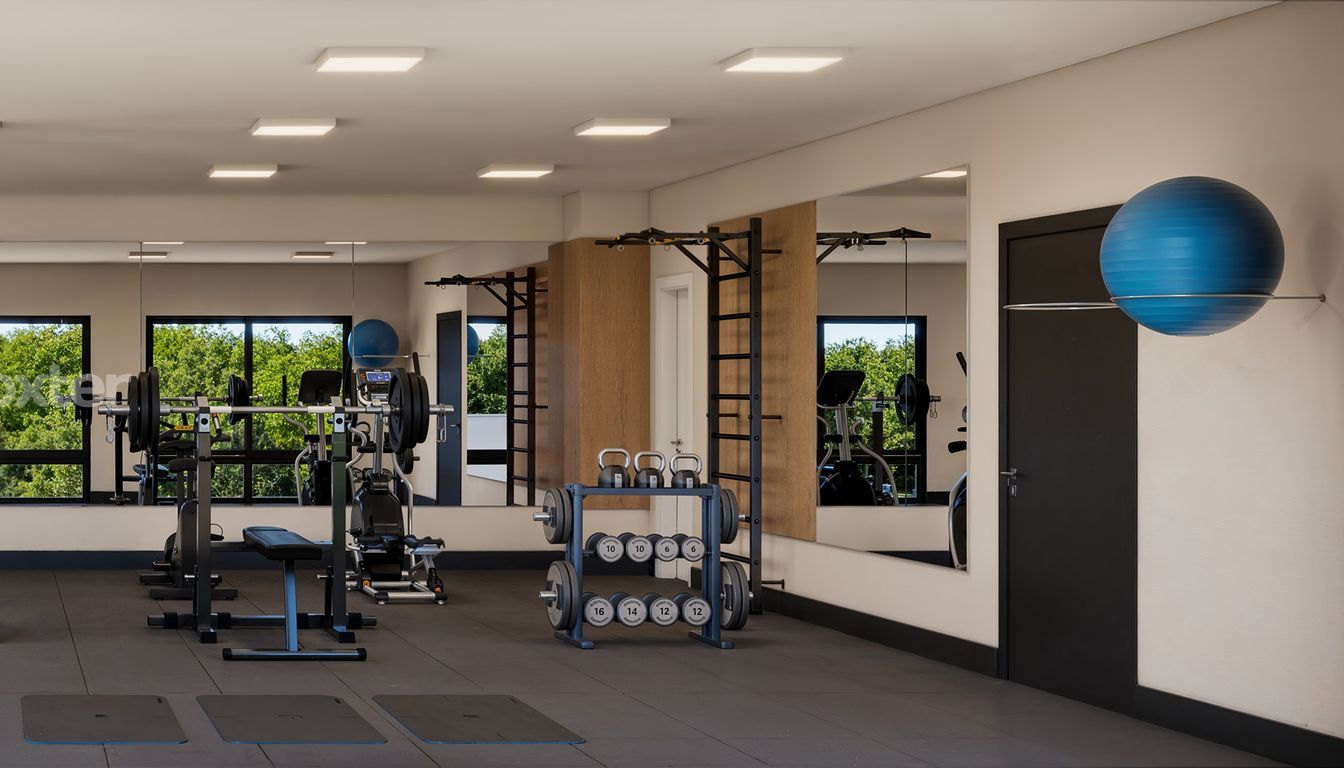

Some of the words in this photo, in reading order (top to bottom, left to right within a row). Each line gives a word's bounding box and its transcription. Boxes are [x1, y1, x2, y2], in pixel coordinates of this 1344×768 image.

[606, 545, 616, 553] 10
[635, 545, 645, 553] 10
[594, 607, 605, 616] 16
[627, 607, 637, 616] 14
[660, 607, 670, 616] 12
[692, 607, 702, 616] 12
